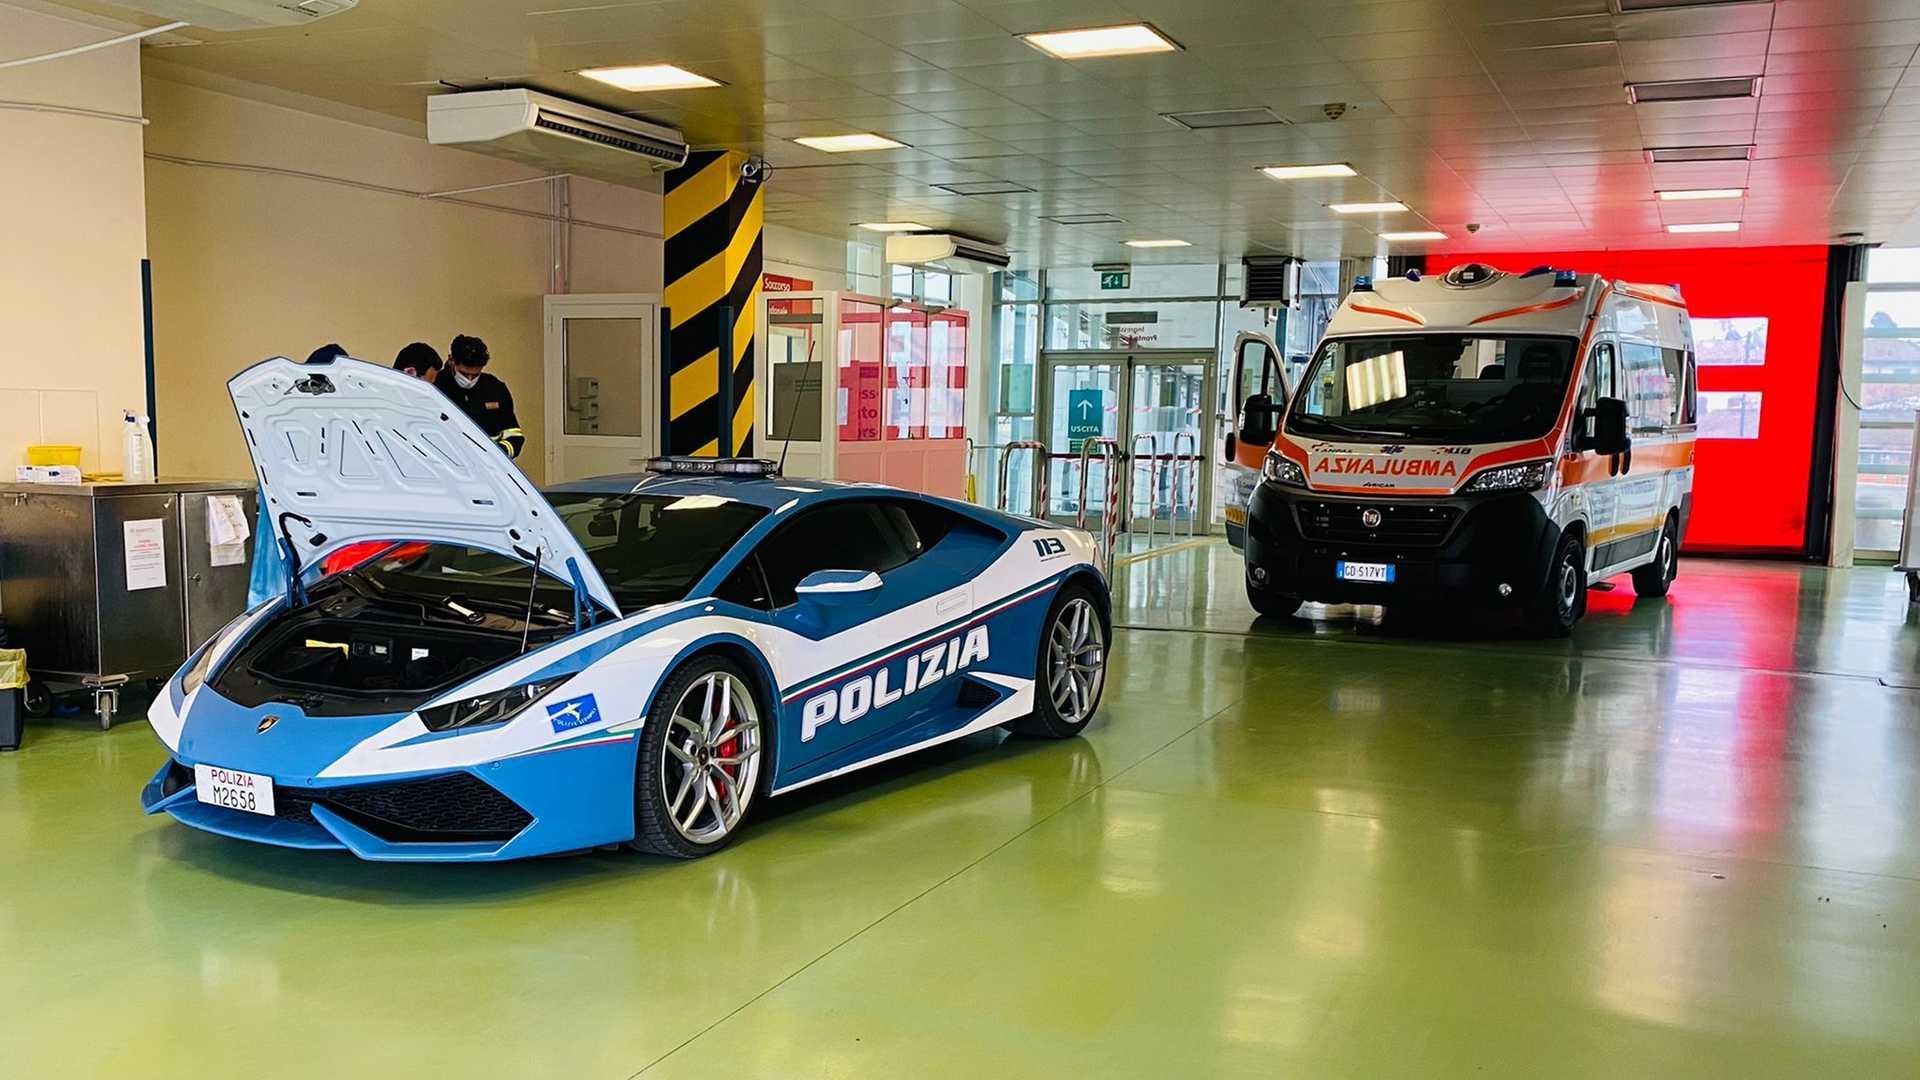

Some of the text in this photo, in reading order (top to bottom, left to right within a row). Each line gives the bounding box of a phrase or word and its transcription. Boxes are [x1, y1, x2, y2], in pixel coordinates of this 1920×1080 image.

[764, 277, 791, 292] Soccorso
[1070, 425, 1100, 433] USCITA
[1033, 537, 1066, 557] 113
[801, 624, 990, 742] POLIZIA
[210, 769, 255, 788] POLIZIA
[213, 785, 256, 811] M2658
